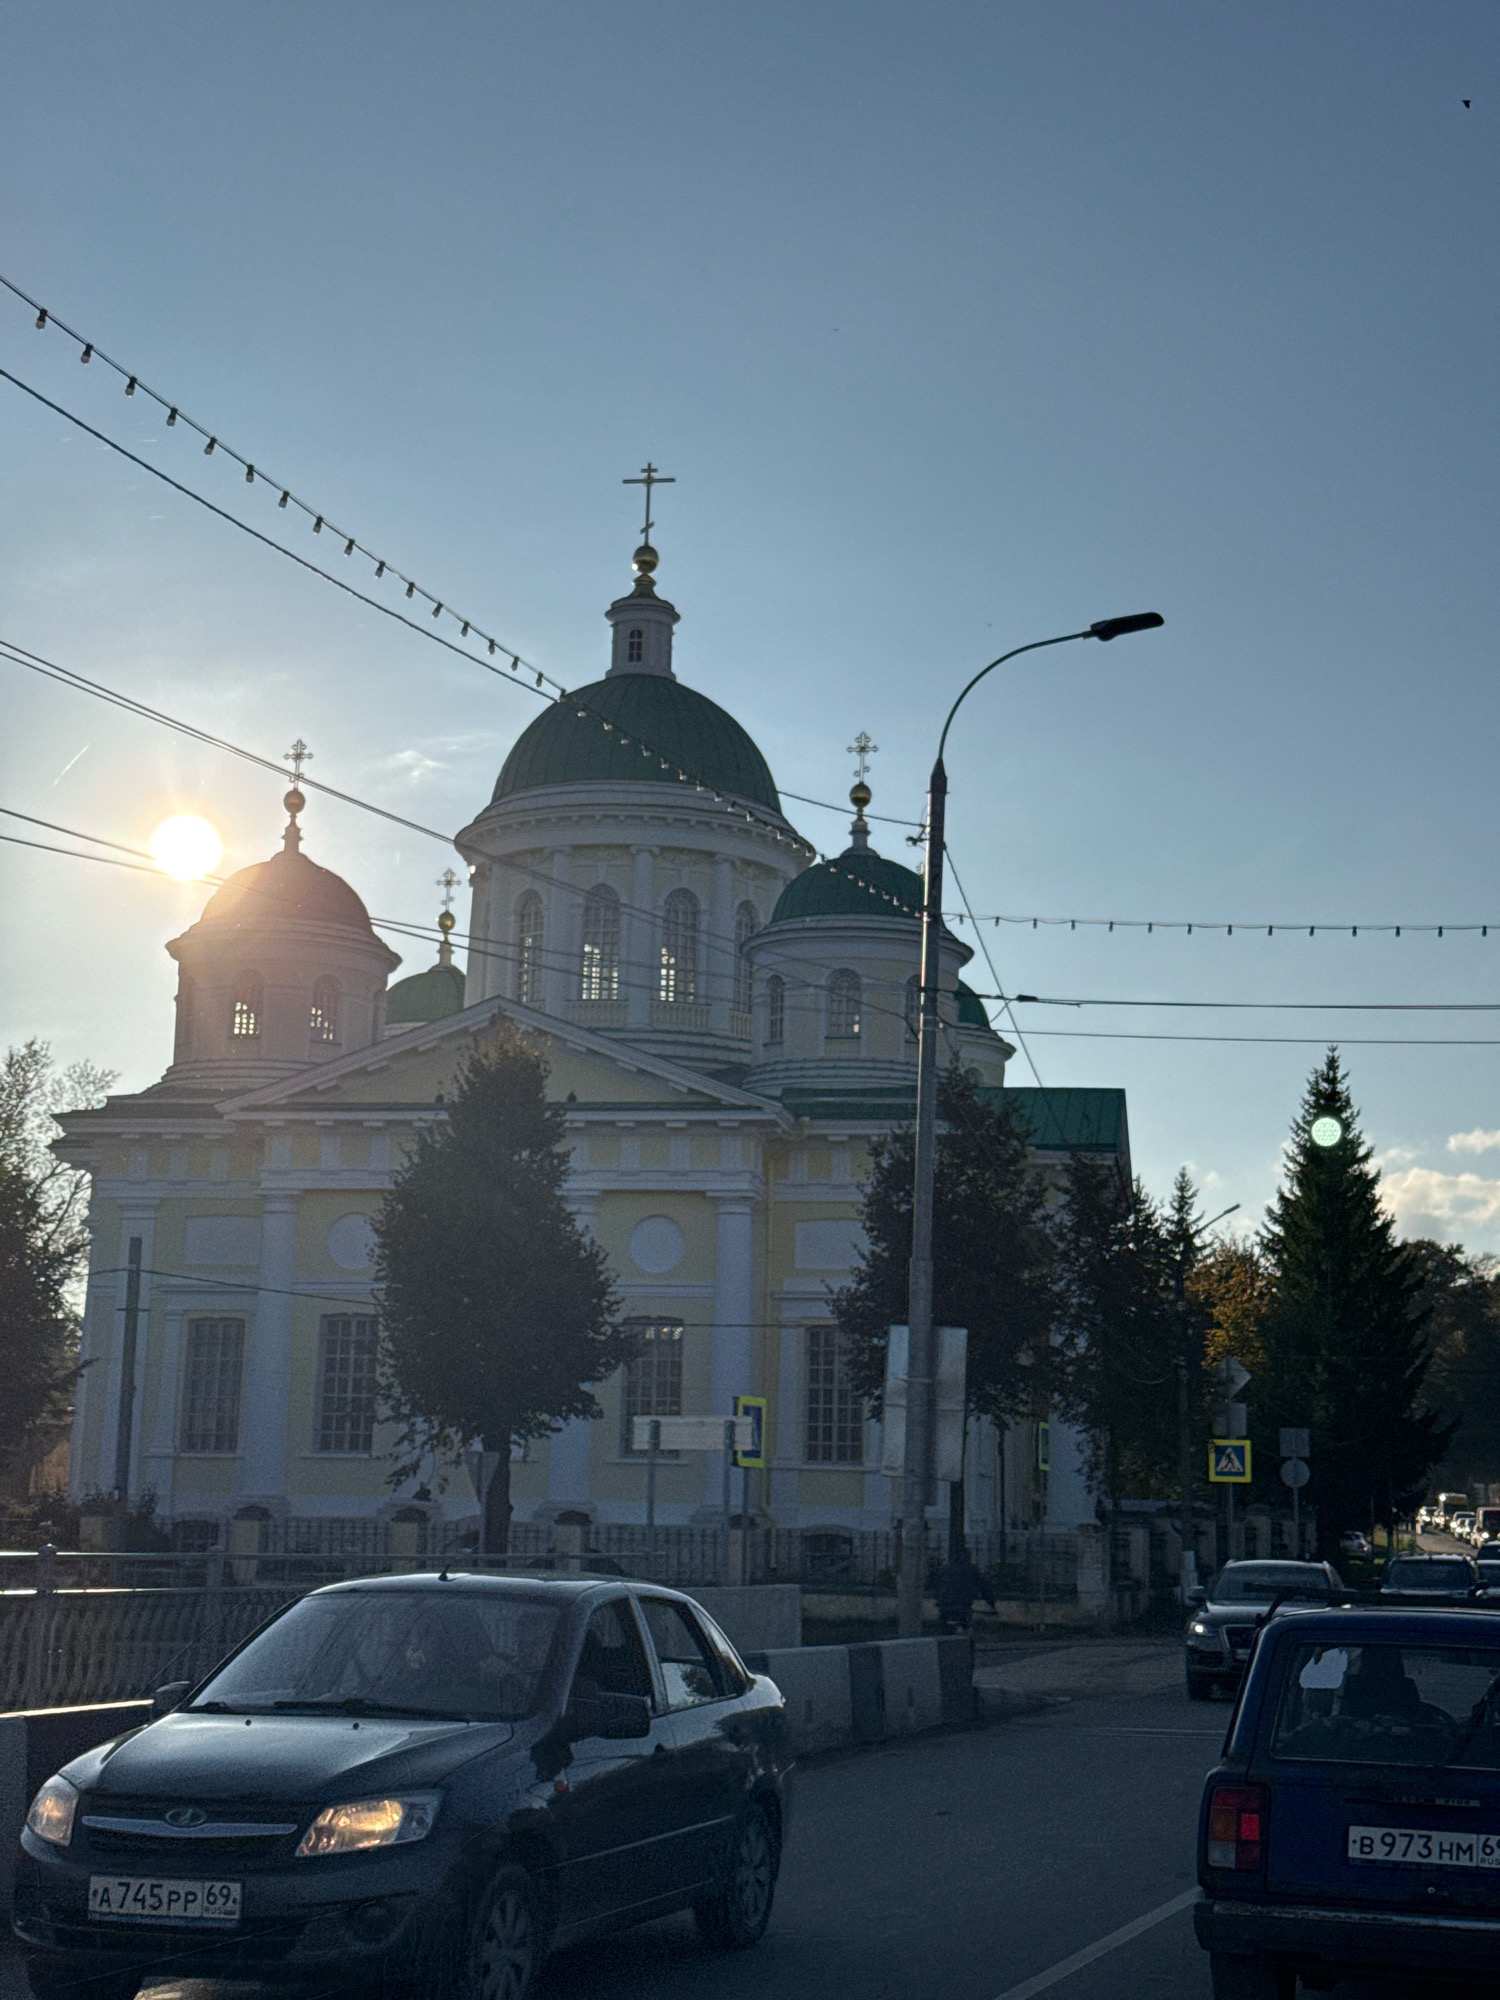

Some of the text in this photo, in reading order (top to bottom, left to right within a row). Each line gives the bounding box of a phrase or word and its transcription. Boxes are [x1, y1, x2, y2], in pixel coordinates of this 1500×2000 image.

[1360, 1832, 1500, 1862] В973НМ 6
[99, 1881, 232, 1912] А745РР 69
